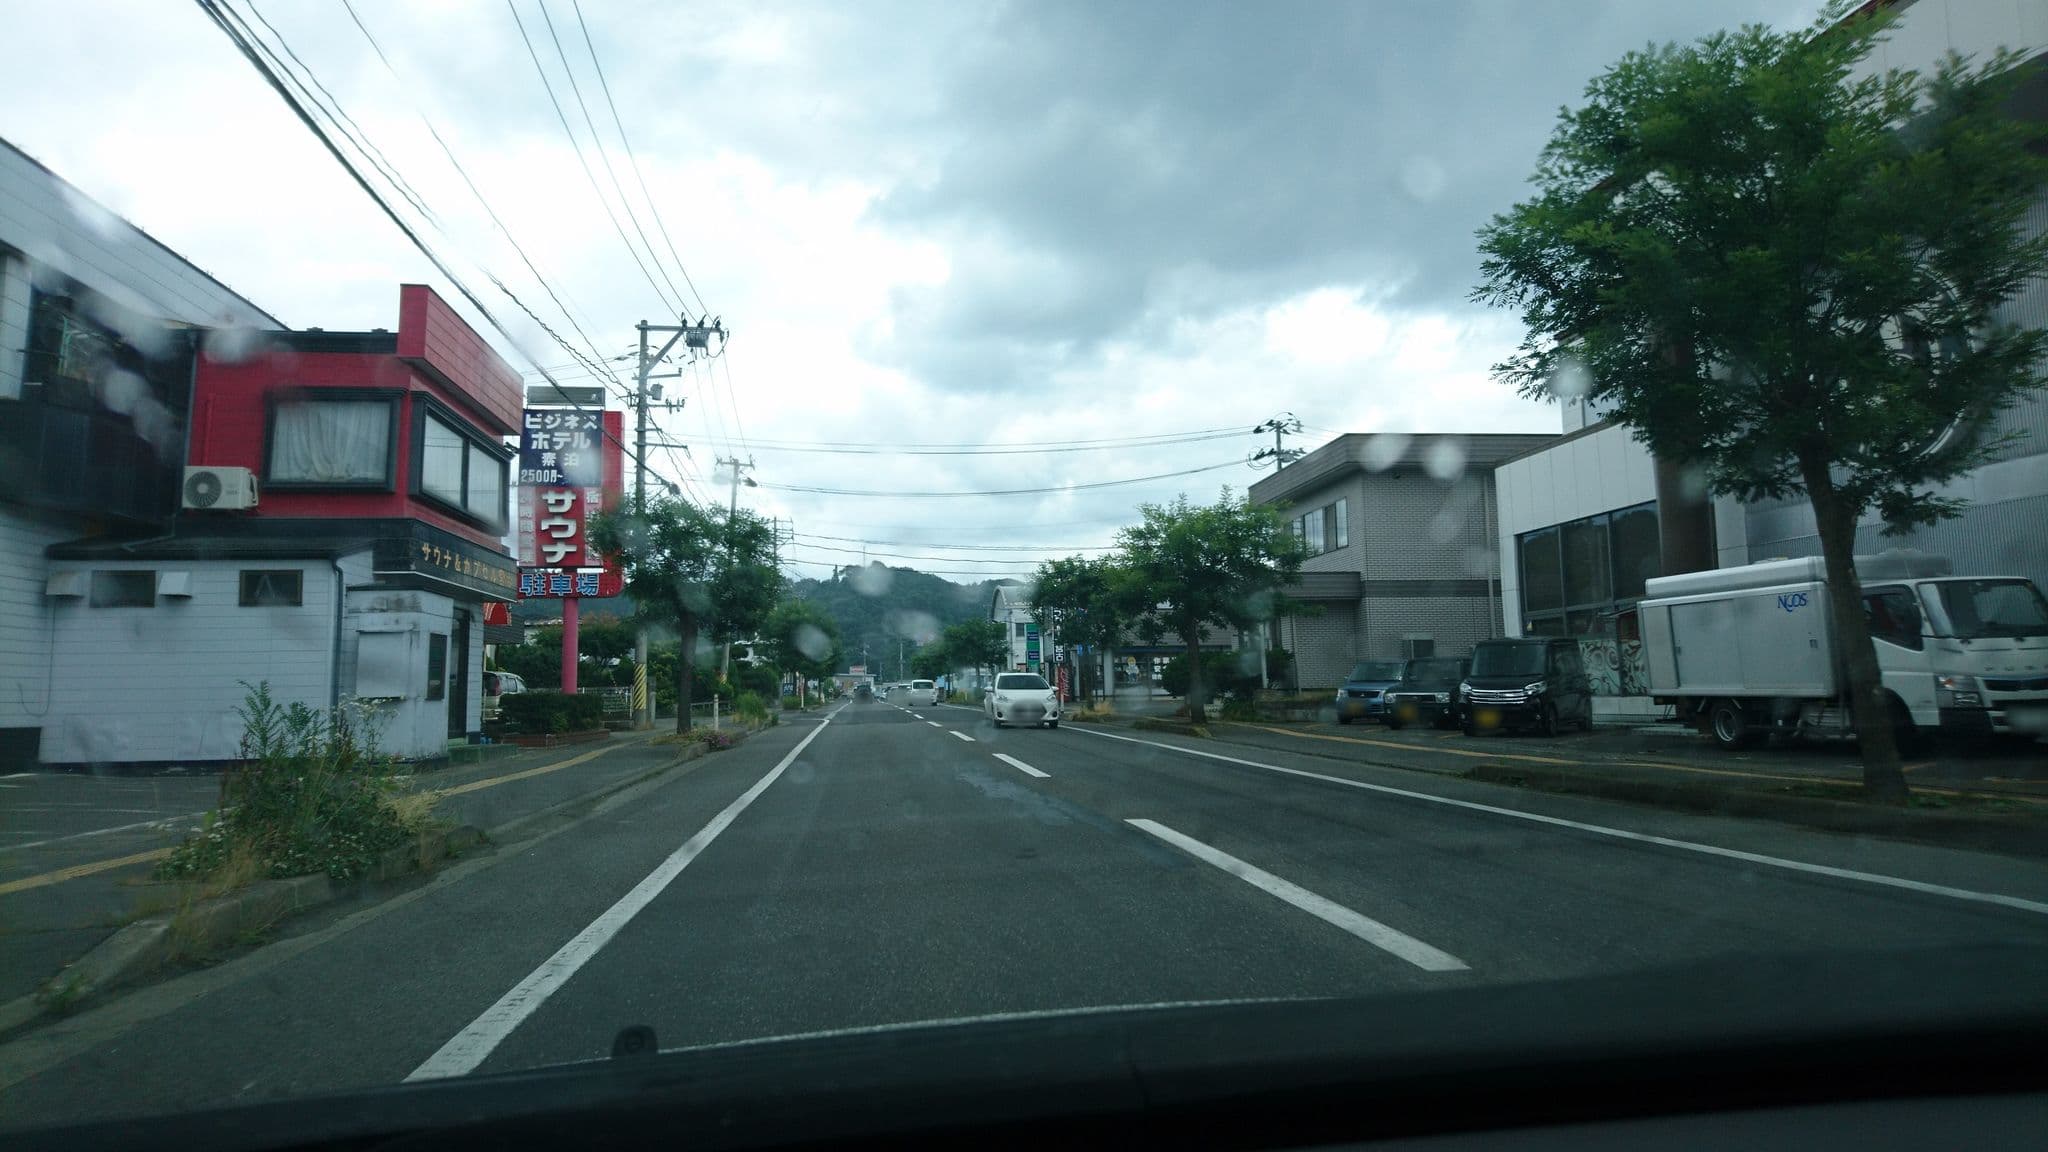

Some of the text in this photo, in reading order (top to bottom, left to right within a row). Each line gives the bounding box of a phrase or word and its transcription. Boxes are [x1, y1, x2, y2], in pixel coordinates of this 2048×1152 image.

[531, 432, 591, 450] ホテル
[541, 490, 577, 563] サウナ
[519, 573, 600, 596] 駐車場
